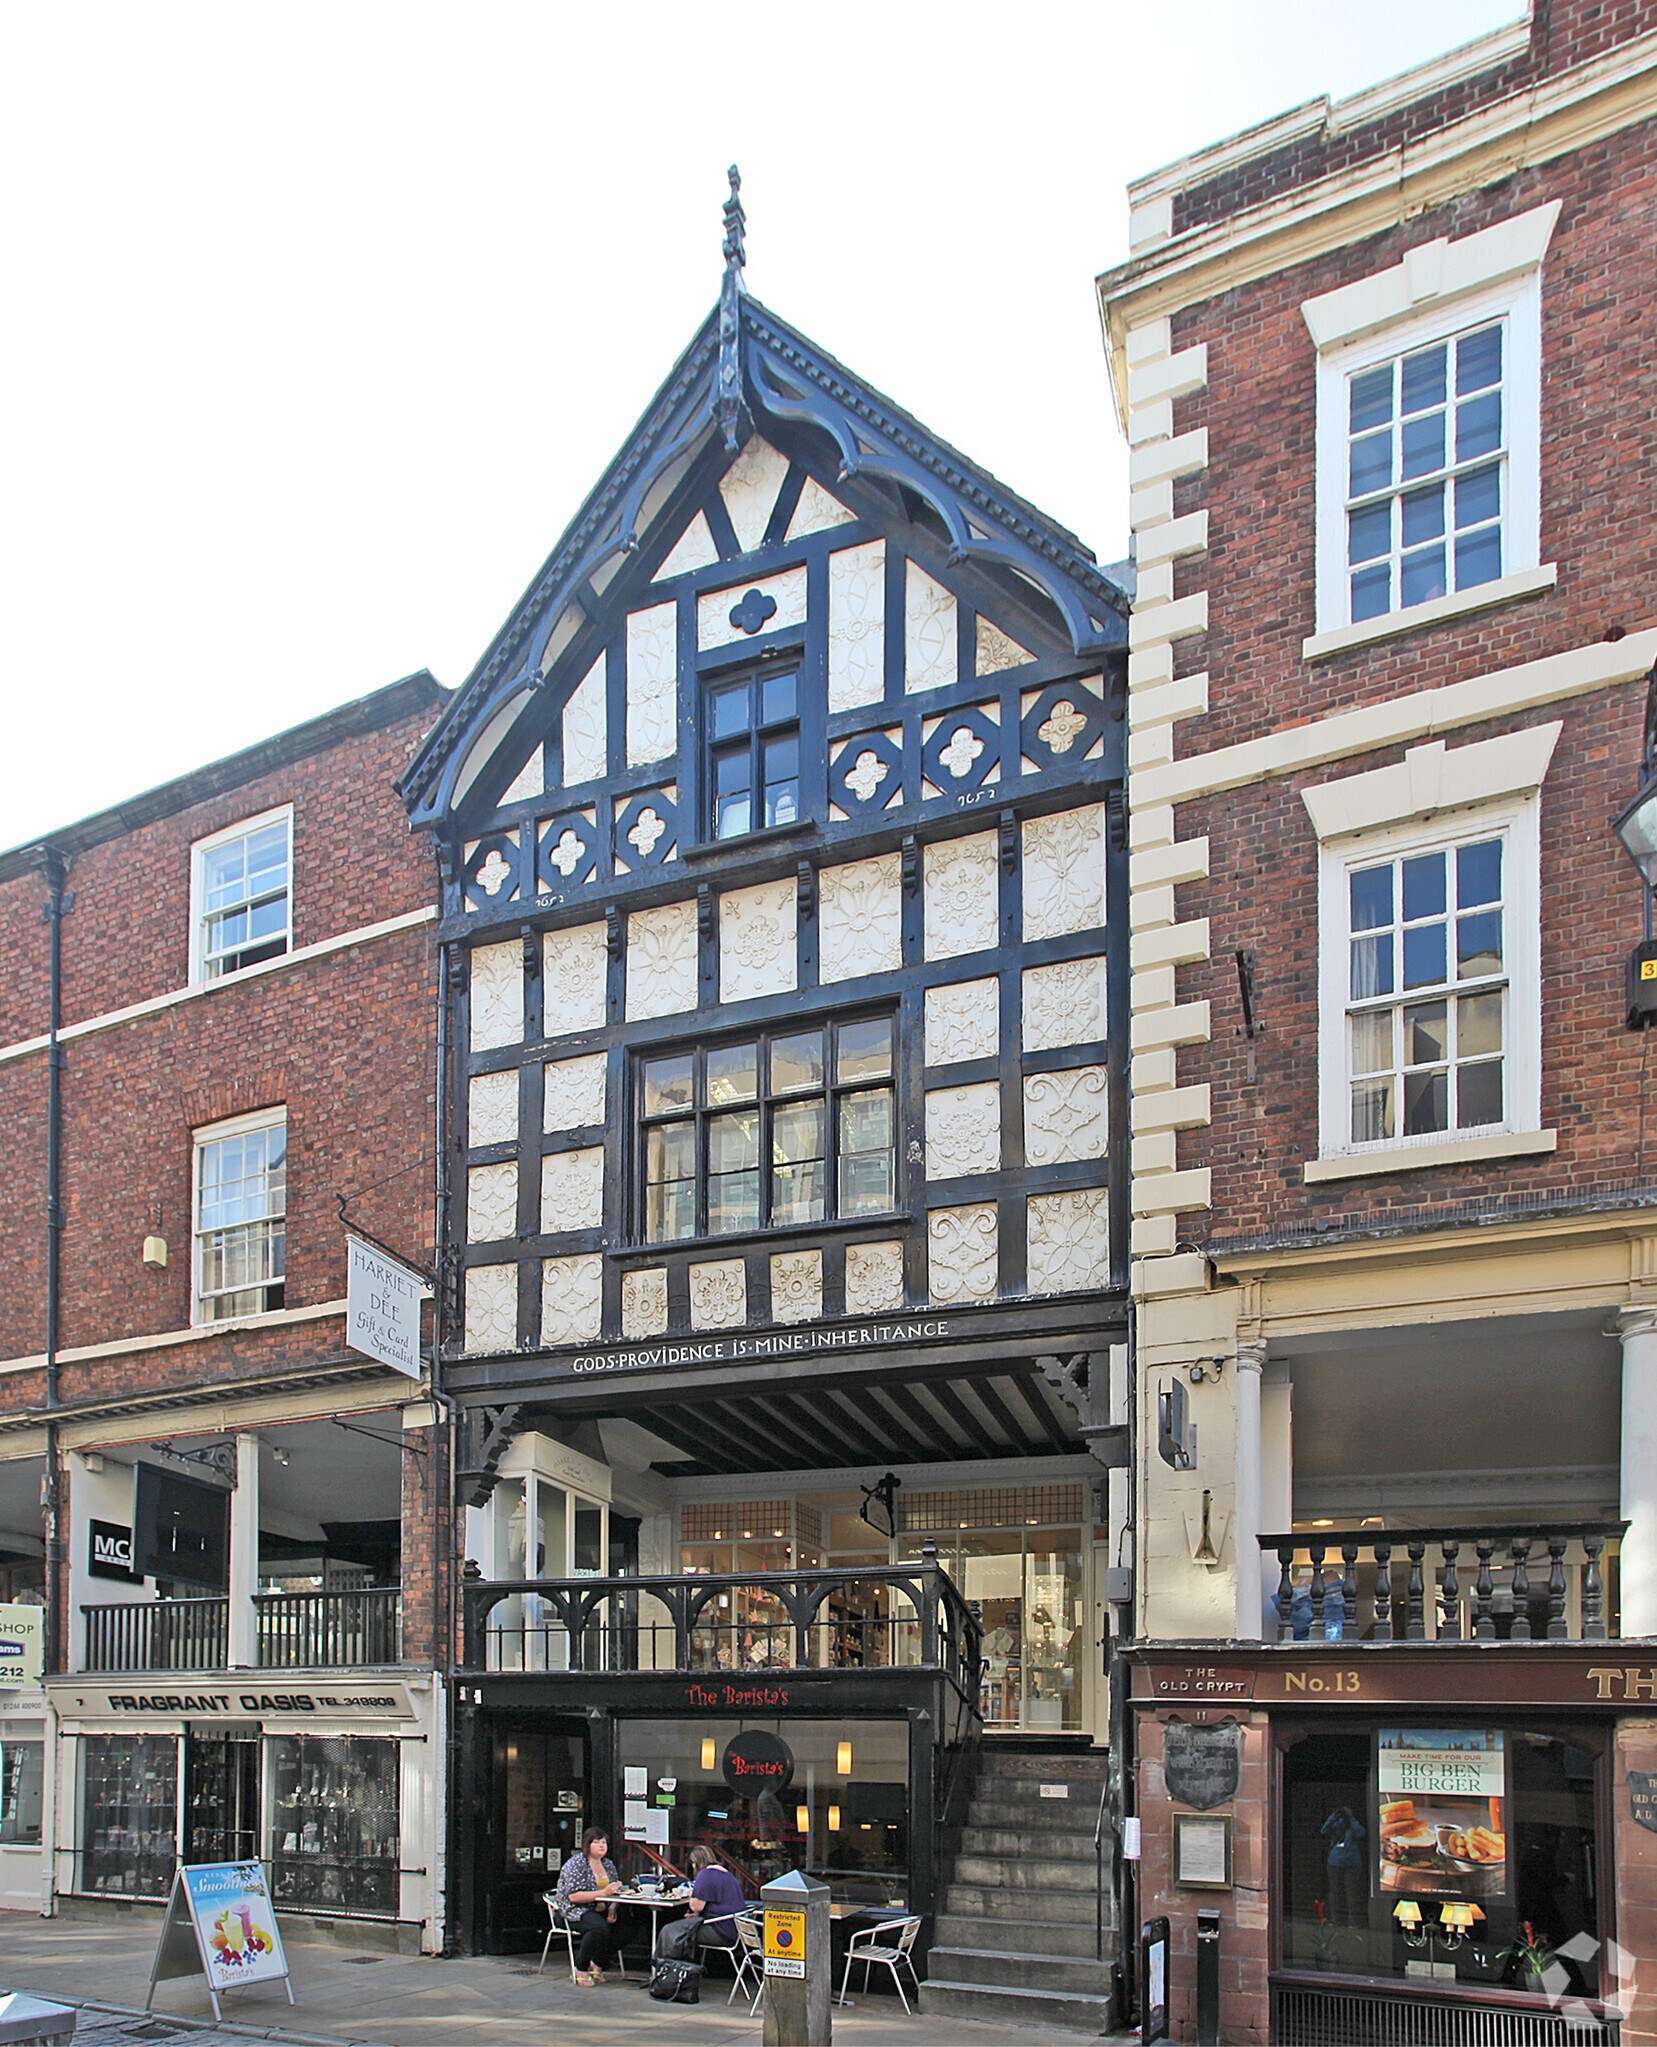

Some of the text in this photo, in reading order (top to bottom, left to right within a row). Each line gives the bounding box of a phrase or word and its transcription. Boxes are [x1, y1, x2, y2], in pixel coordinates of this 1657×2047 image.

[354, 1250, 417, 1299] HARRIET
[381, 1286, 391, 1299] &
[370, 1292, 402, 1324] DEE
[356, 1310, 377, 1333] Gift
[387, 1326, 409, 1349] Card
[370, 1333, 414, 1366] Specialist
[1185, 1667, 1217, 1678] THE
[1160, 1681, 1245, 1692] OLD CRYPT
[684, 1683, 789, 1706] The Barista's
[107, 1695, 230, 1711] FRAGRANT
[239, 1695, 316, 1711] OASIS
[732, 1756, 784, 1776] Barista's
[1400, 1763, 1482, 1778] BIG BEN
[1401, 1777, 1482, 1792] BURGER
[768, 1912, 801, 1921] Restricted
[777, 1920, 793, 1928] Zone
[778, 1961, 802, 1970] loading
